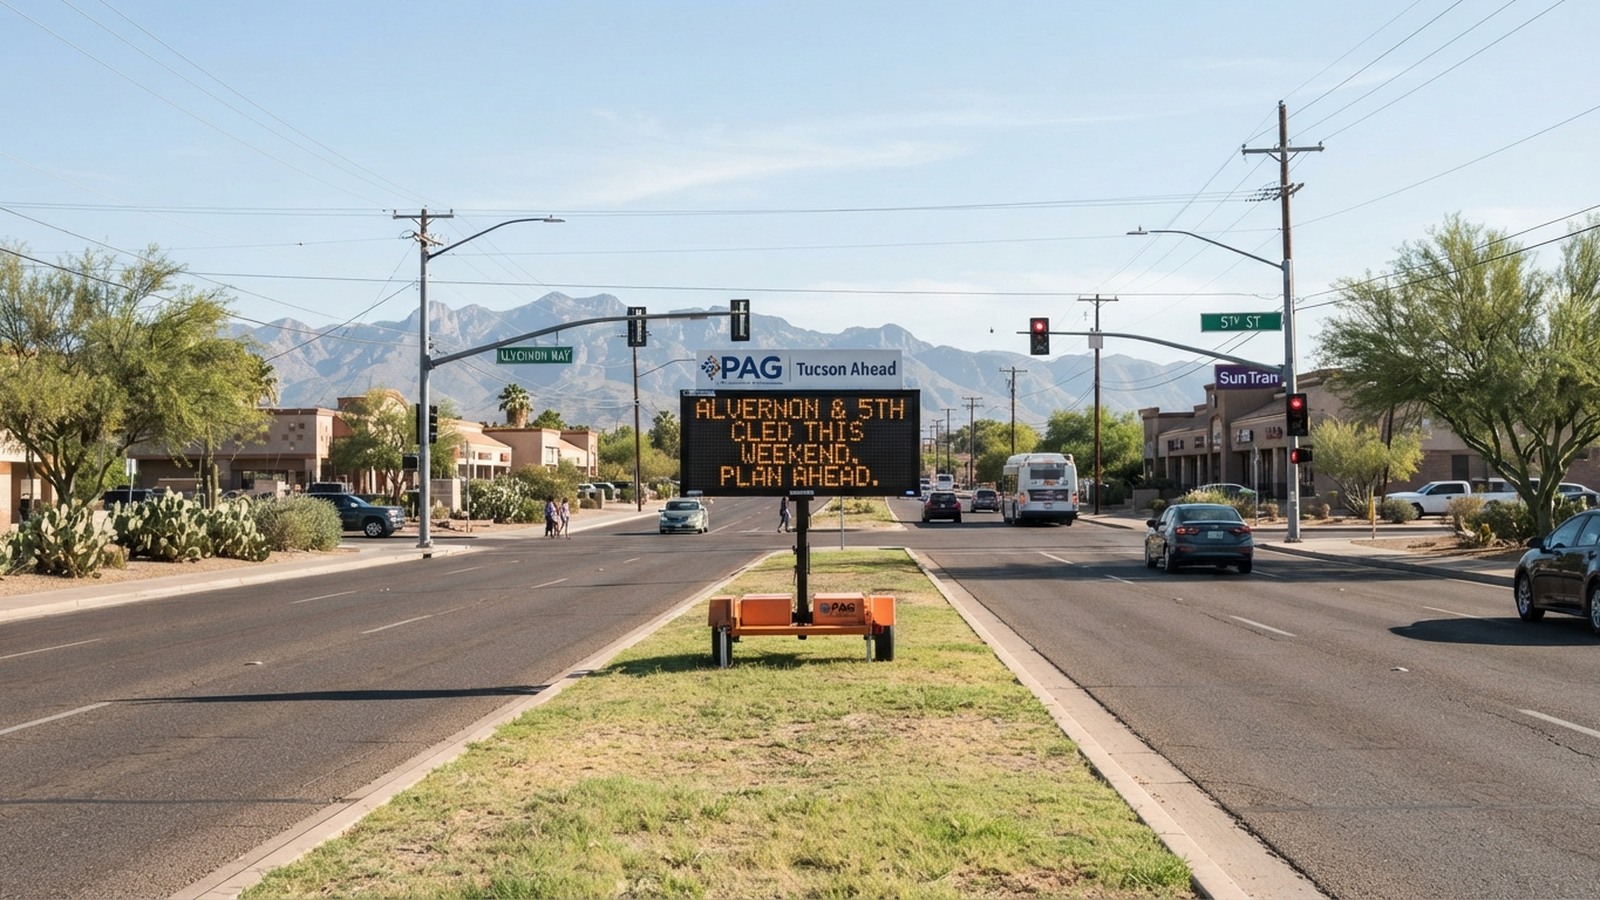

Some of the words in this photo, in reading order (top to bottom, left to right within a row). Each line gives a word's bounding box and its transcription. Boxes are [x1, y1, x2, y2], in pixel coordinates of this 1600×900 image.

[1246, 315, 1261, 329] ST
[721, 356, 783, 379] PAG
[796, 362, 847, 377] Tucson
[850, 360, 897, 376] Ahead
[1220, 372, 1247, 384] Sun
[1248, 371, 1279, 384] Tran
[695, 398, 819, 420] ALVERNON
[831, 398, 847, 420] &
[858, 398, 905, 420] 5TH
[731, 421, 793, 442] CLED
[804, 421, 864, 442] THIS
[720, 465, 782, 487] PLAN
[793, 465, 880, 487] AHEAD.
[832, 602, 855, 613] PAG
